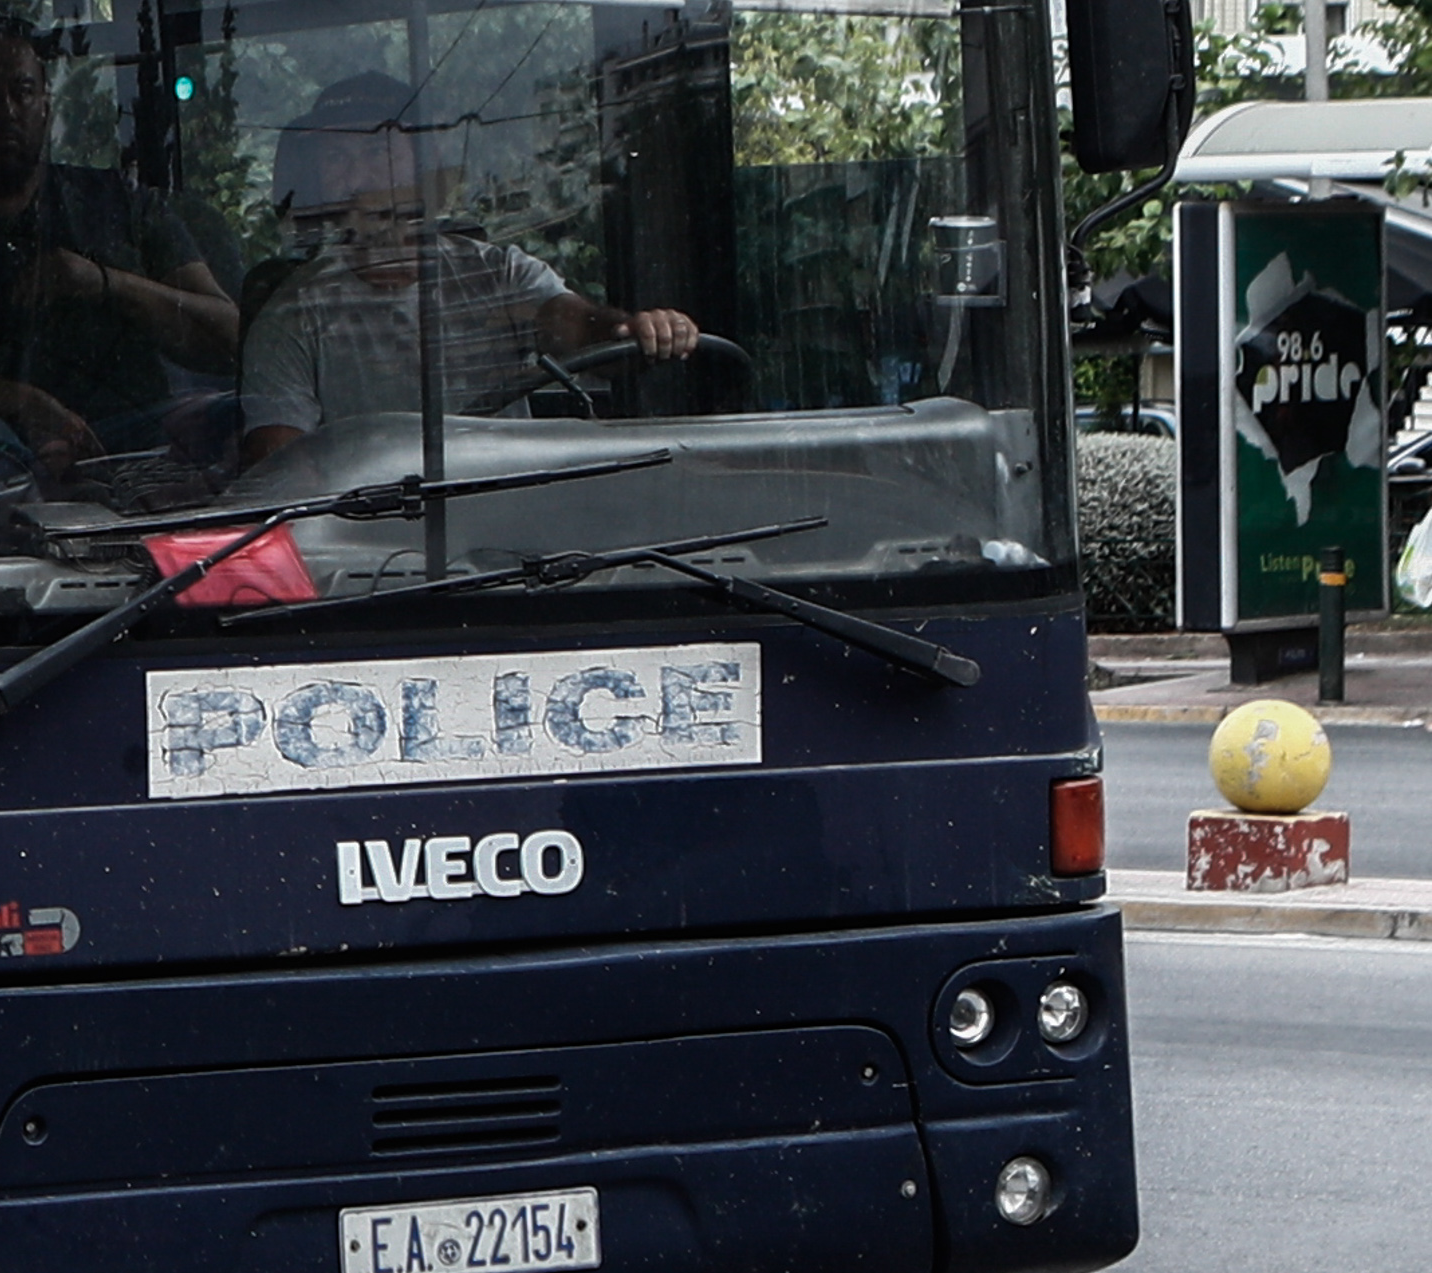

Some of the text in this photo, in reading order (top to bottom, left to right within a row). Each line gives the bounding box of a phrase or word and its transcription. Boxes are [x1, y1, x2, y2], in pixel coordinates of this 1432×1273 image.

[1277, 330, 1324, 362] 98.6
[1252, 352, 1361, 415] pride
[165, 661, 741, 777] POLICE
[336, 830, 584, 906] IVECO
[464, 1202, 576, 1268] 22154
